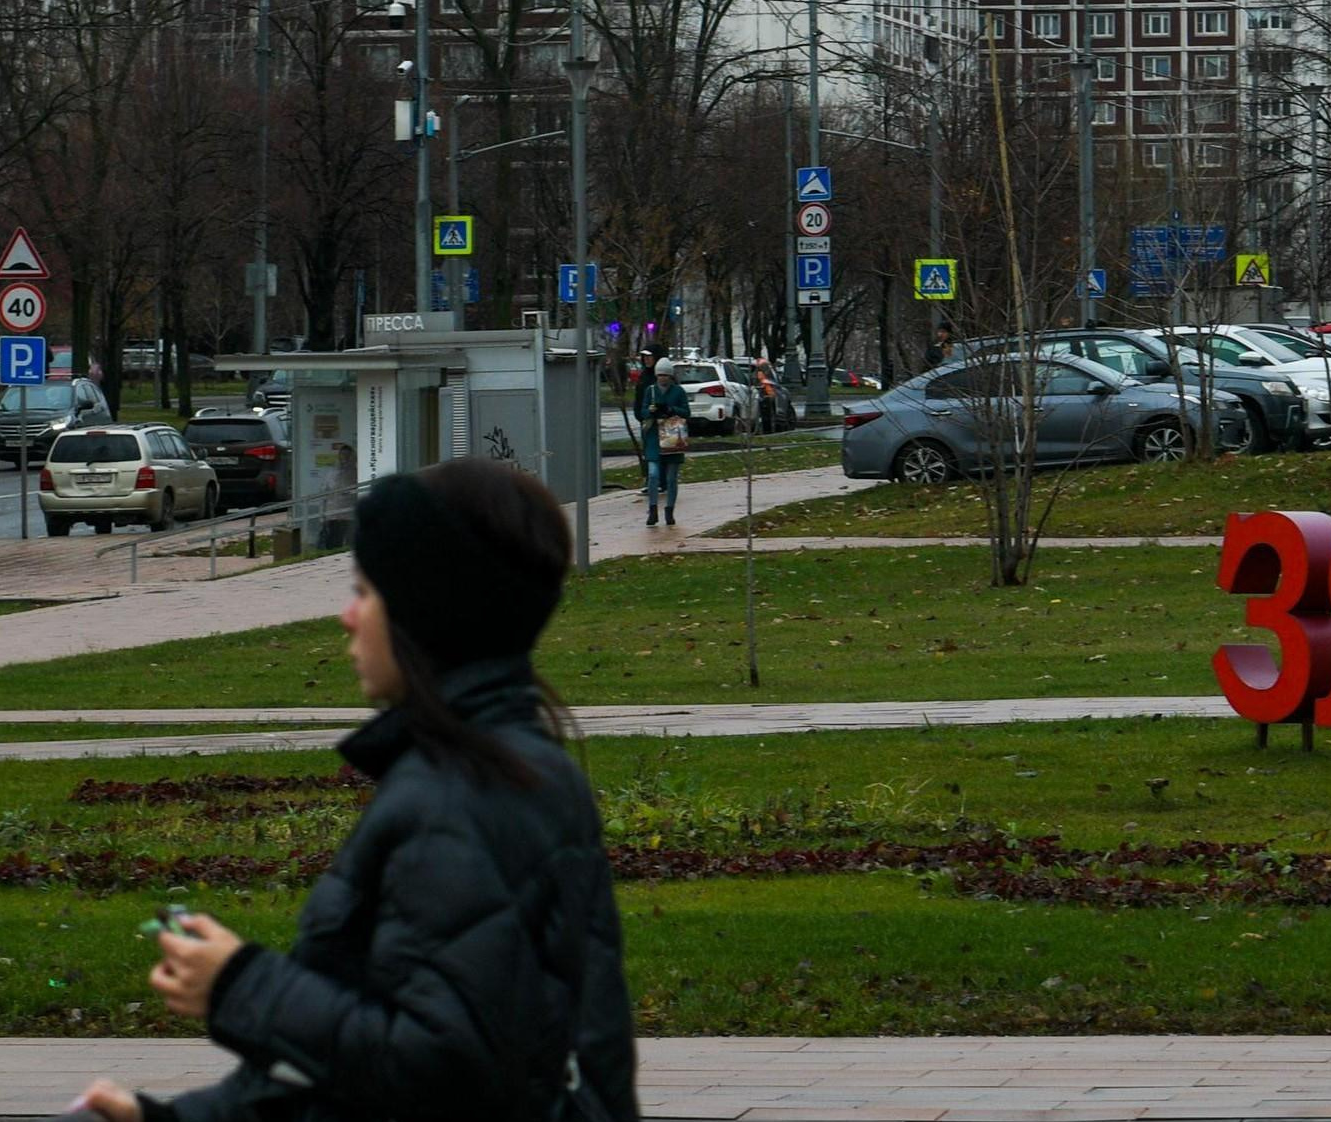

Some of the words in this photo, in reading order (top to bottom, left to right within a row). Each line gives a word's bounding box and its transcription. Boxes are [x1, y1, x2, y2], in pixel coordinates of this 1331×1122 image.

[806, 213, 822, 227] 20
[805, 259, 822, 284] P
[8, 298, 35, 317] 40
[366, 315, 425, 331] ПРЕССА
[10, 344, 33, 378] P
